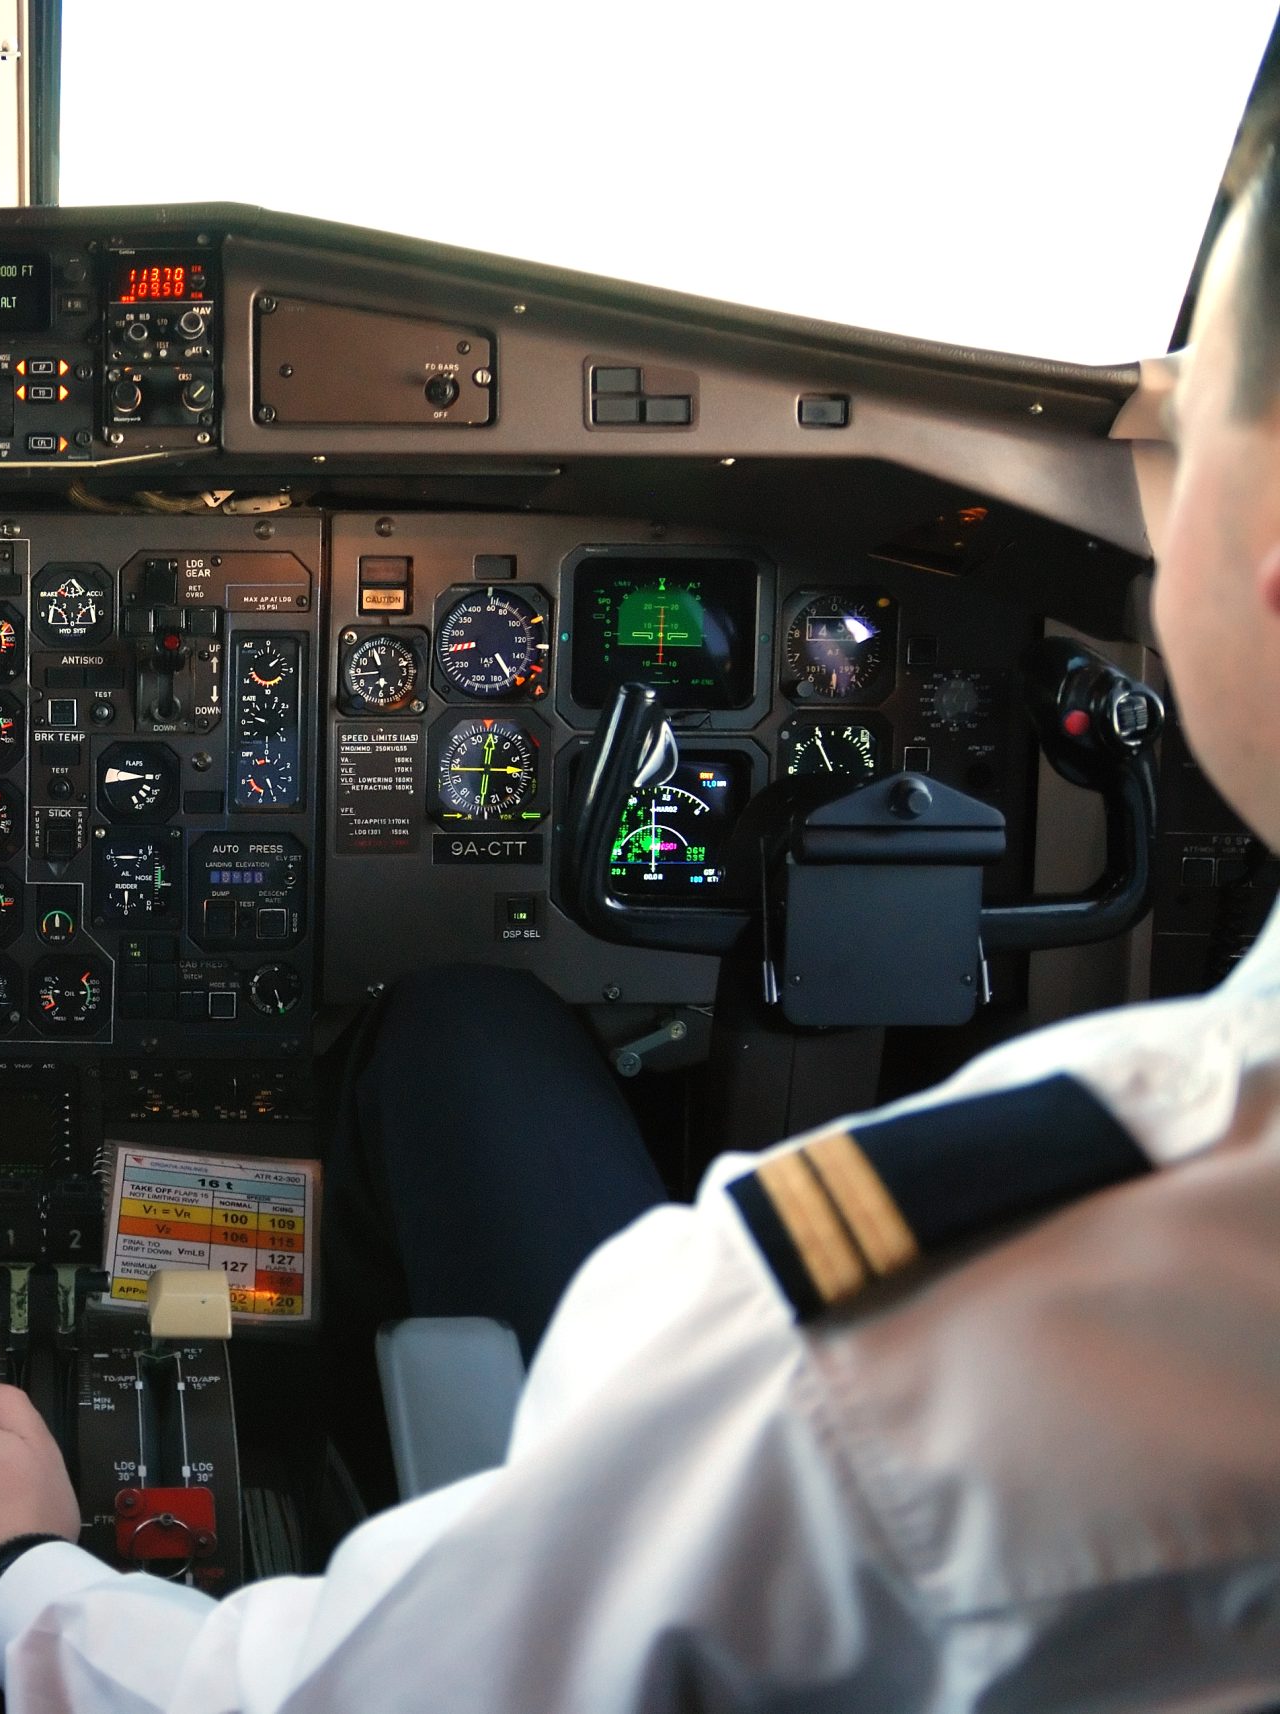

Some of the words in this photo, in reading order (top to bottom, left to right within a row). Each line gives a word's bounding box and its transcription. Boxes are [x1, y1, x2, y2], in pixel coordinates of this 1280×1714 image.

[21, 265, 33, 277] FT
[0, 296, 17, 309] ALT
[192, 306, 212, 315] NAV
[191, 346, 202, 354] ACT
[426, 363, 436, 371] FD
[438, 363, 460, 371] BARS
[186, 559, 204, 568] LDG
[186, 569, 211, 577] GEAR
[365, 595, 401, 604] CAUTION
[498, 608, 508, 616] 80
[458, 616, 472, 624] 350
[508, 620, 521, 628] 100
[450, 629, 465, 637] 300
[515, 636, 527, 644] 120
[209, 644, 221, 652] UP
[377, 646, 386, 655] 12
[61, 656, 104, 665] ANTISKID
[359, 657, 368, 666] 10
[195, 707, 221, 715] DOWN
[34, 733, 54, 741] BRK
[59, 733, 86, 741] TEMP
[341, 734, 369, 742] SPEED
[371, 734, 398, 742] LIMITS
[400, 734, 419, 742] (IAS)
[48, 809, 72, 817] STICK
[212, 845, 240, 853] AUTO
[249, 845, 284, 853] PRESS
[451, 841, 527, 856] 9A-CTT
[503, 930, 521, 939] DSP
[523, 930, 541, 938] SEL
[197, 1178, 220, 1188] 16
[226, 1181, 234, 1190] t
[272, 1175, 301, 1184] 42-300
[130, 1184, 153, 1193] TAKE
[155, 1186, 173, 1194] OFF
[174, 1189, 198, 1198] FLAPS
[147, 1193, 180, 1202] LIMITING
[219, 1200, 253, 1210] NORMAL
[272, 1206, 294, 1214] ICING
[222, 1213, 248, 1225] 100
[270, 1218, 295, 1230] 109
[69, 1230, 82, 1249] 2
[222, 1231, 248, 1243] 106
[123, 1238, 146, 1247] FINAL
[148, 1240, 161, 1248] T/O
[270, 1236, 295, 1248] 115
[122, 1245, 146, 1253] DRIFT
[148, 1247, 172, 1256] DOWN
[268, 1253, 295, 1266] 127
[121, 1261, 157, 1270] MINIMUM
[221, 1261, 248, 1273] 127
[267, 1296, 295, 1307] 120
[103, 1375, 136, 1383] TO/APP
[114, 1461, 136, 1471] LDG
[192, 1462, 214, 1472] LDG
